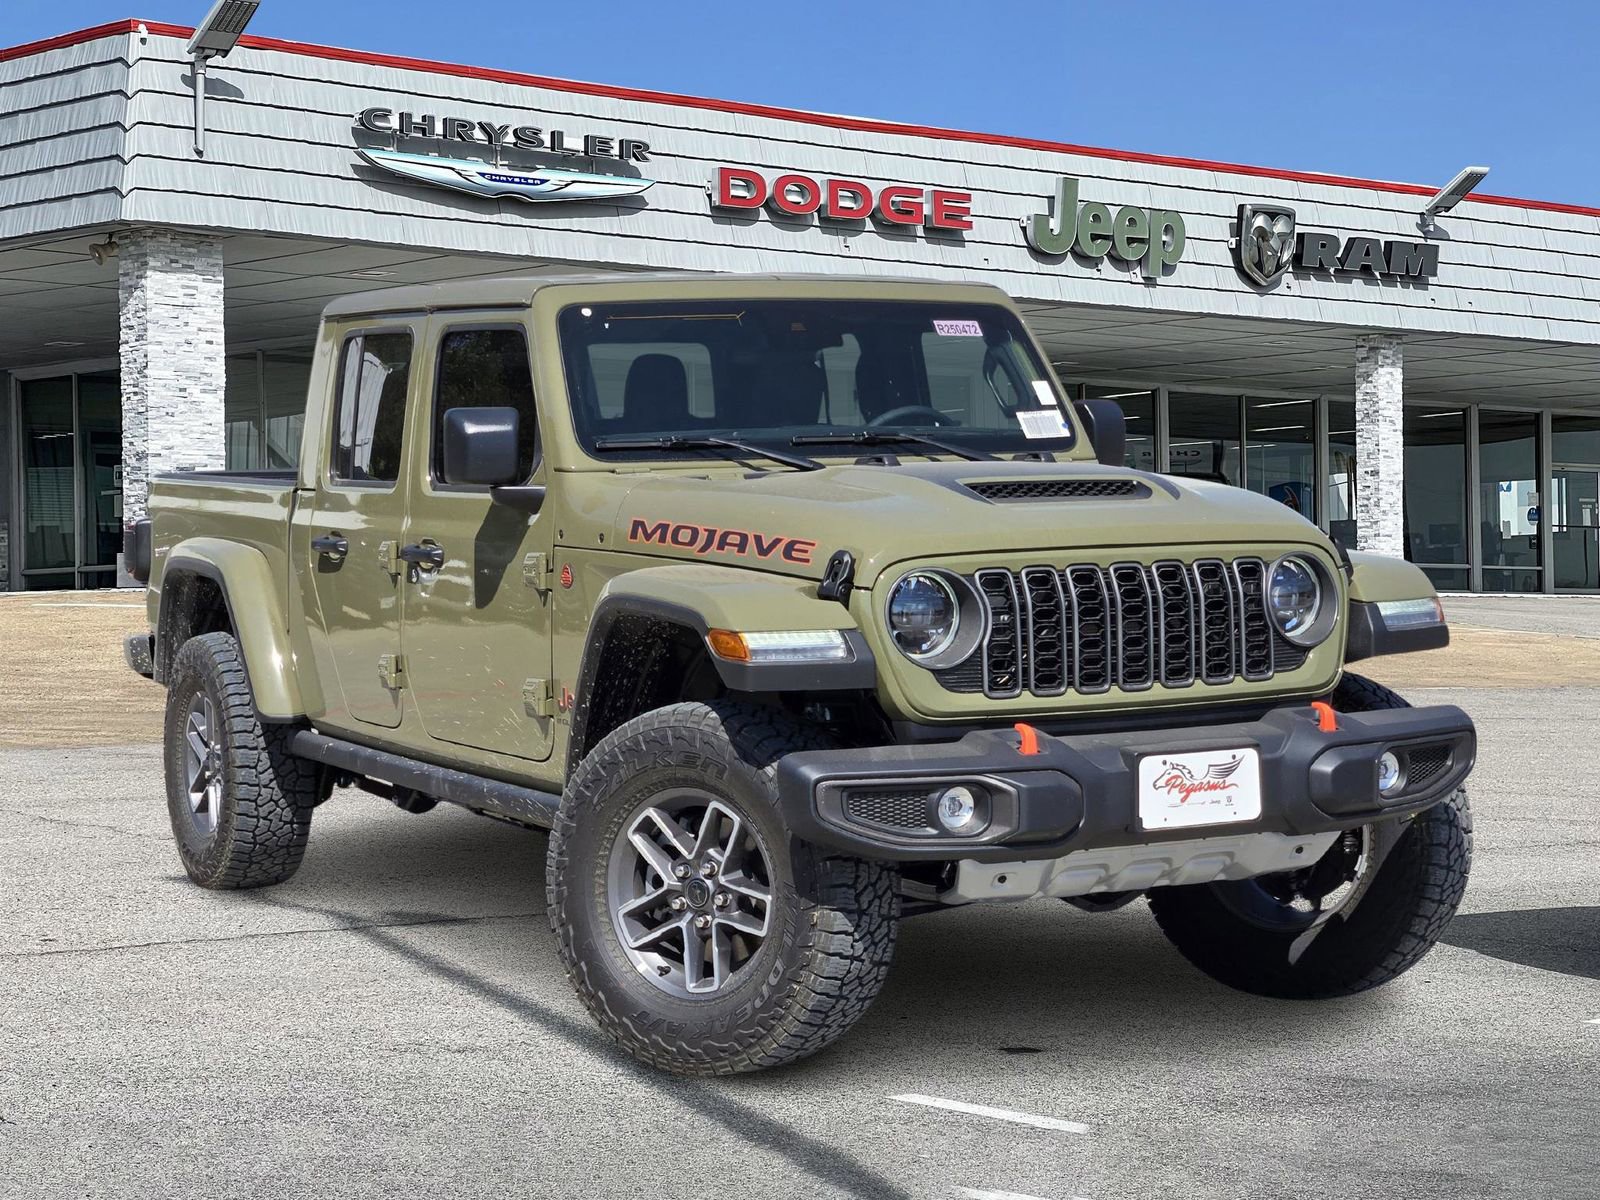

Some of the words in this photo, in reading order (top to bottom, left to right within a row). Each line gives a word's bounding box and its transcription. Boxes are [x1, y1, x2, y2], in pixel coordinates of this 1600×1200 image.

[356, 106, 651, 162] CHRYSLER
[484, 174, 541, 184] CHRYSLER
[712, 167, 973, 230] DODGE
[1029, 177, 1186, 278] Jeep
[1299, 232, 1440, 277] RAM
[936, 323, 980, 335] R250472
[628, 517, 817, 566] MOJAVE
[1164, 774, 1239, 803] Pegasus
